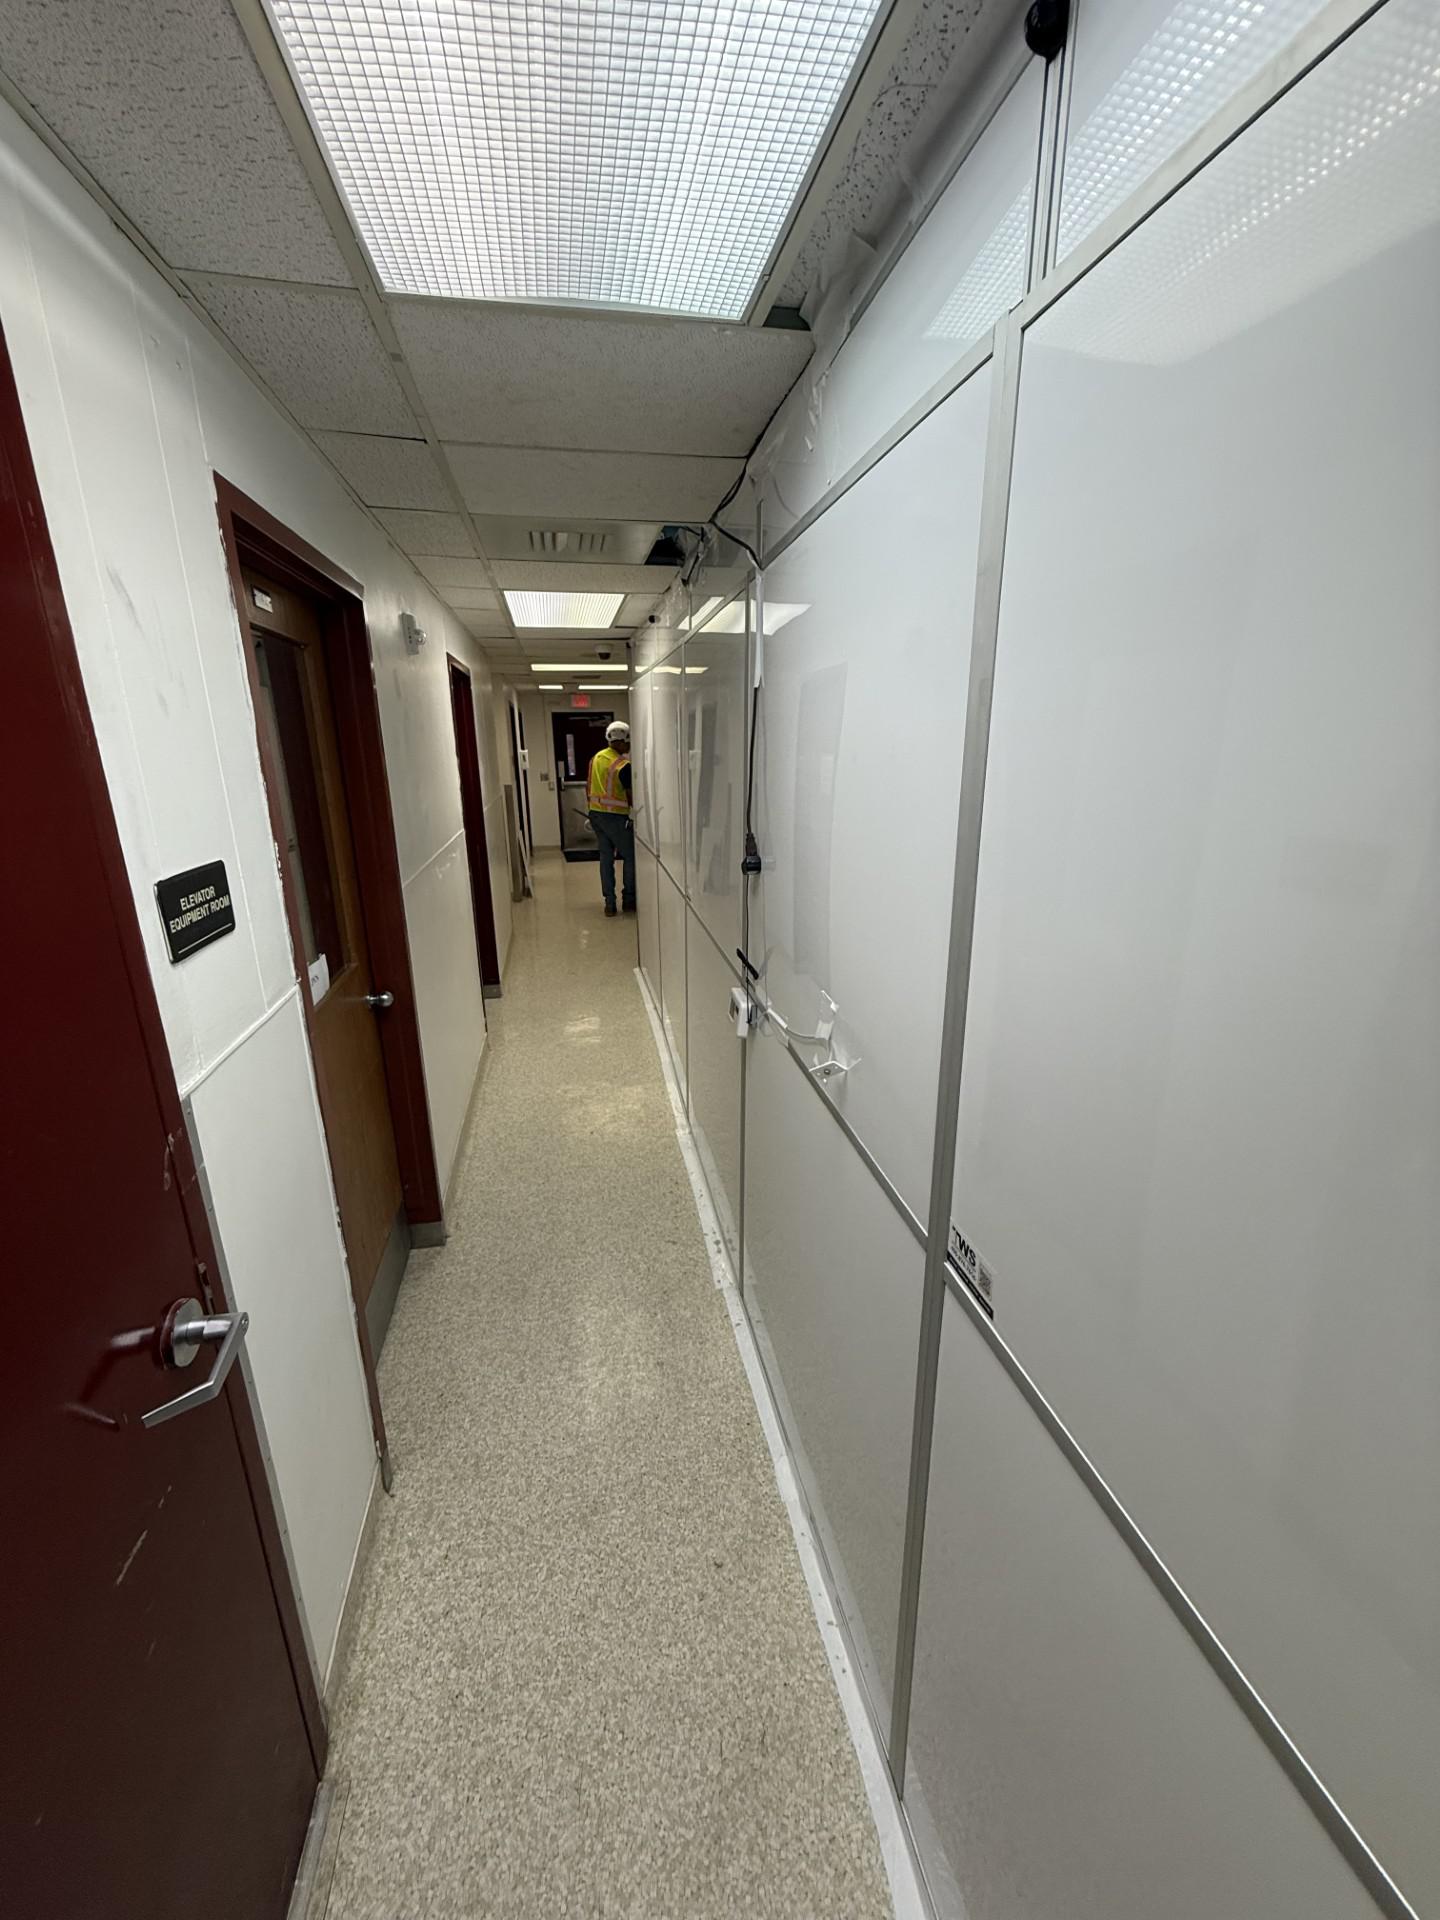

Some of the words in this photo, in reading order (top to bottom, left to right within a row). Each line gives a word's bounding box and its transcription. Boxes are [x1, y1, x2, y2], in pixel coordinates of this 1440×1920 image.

[169, 904, 210, 933] EQUIPMENT
[210, 894, 230, 913] ROOM
[180, 886, 216, 911] ELEVATOR
[952, 1225, 977, 1267] TWS
